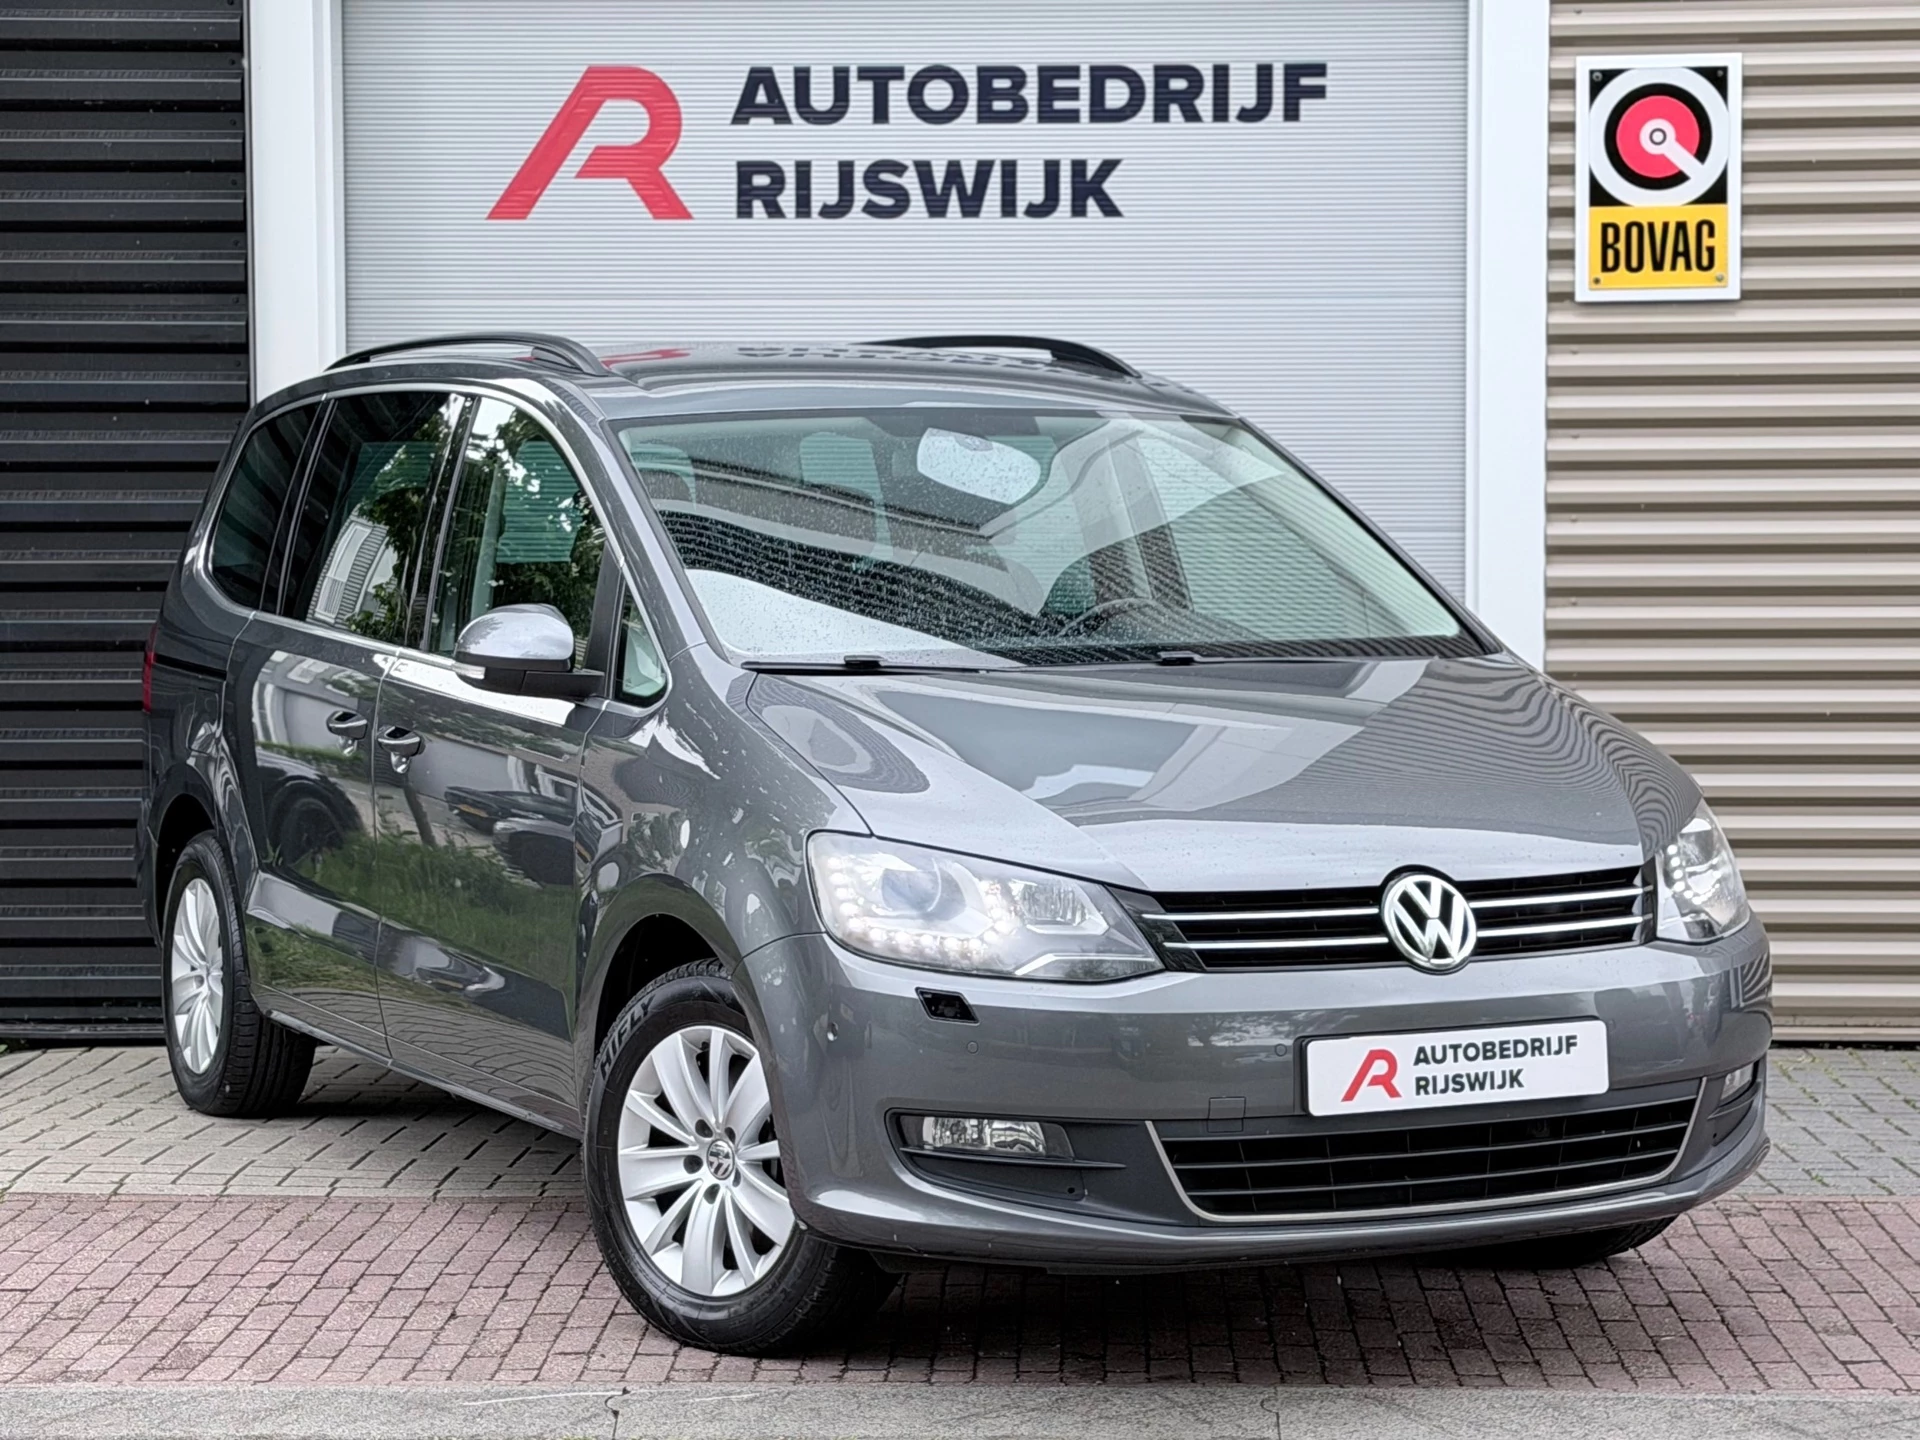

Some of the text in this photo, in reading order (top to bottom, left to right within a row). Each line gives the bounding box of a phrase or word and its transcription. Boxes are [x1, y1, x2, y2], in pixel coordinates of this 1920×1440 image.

[731, 63, 1328, 126] AUTOBEDRIJF
[736, 158, 1124, 219] RIJSWIJK
[1600, 219, 1716, 274] BOVAG
[600, 993, 657, 1081] HIFLY
[1412, 1034, 1578, 1067] AUTOBEDRIJF
[1414, 1068, 1524, 1097] RIJSWIJK
